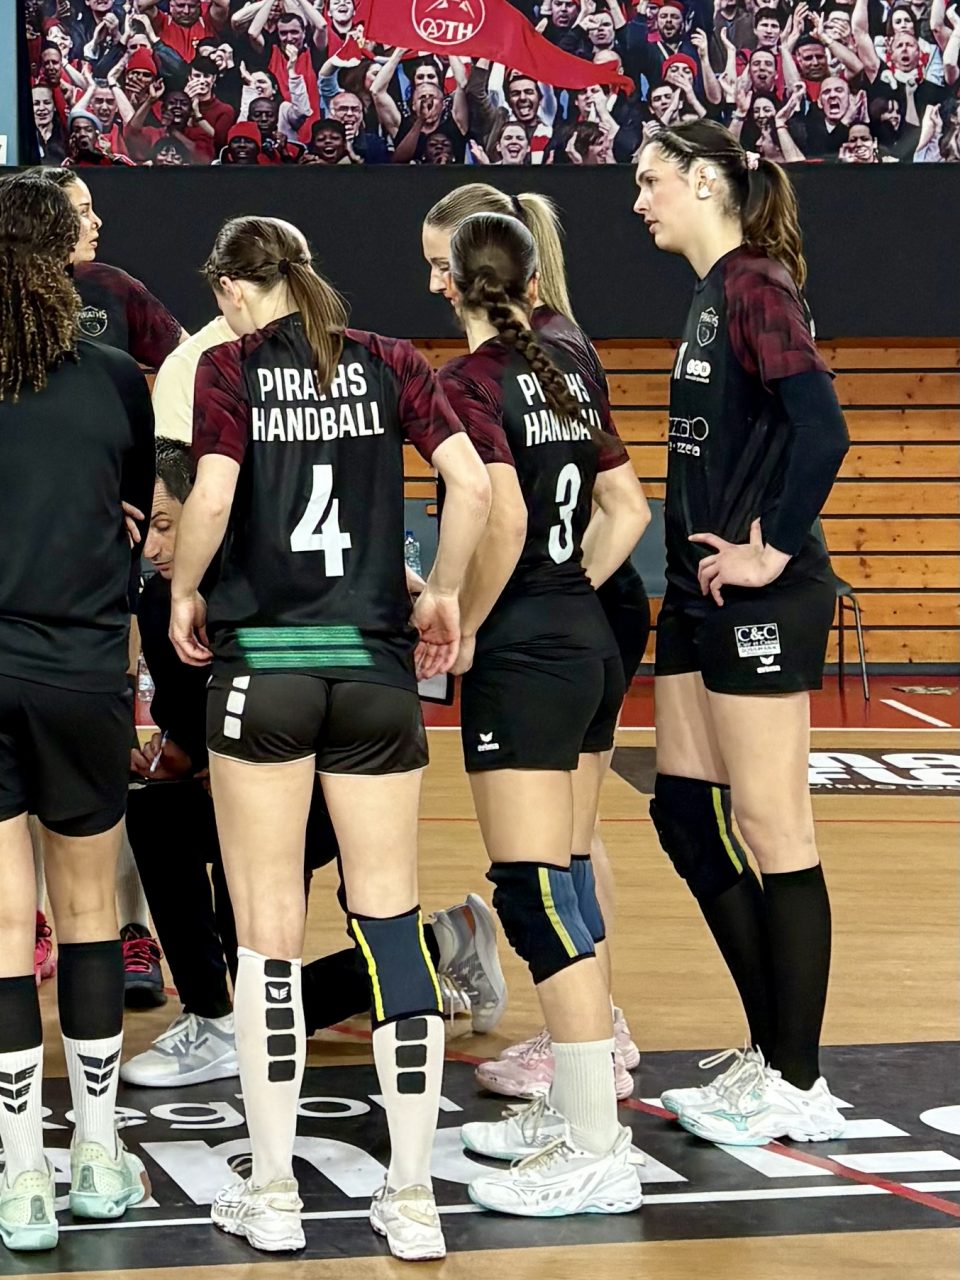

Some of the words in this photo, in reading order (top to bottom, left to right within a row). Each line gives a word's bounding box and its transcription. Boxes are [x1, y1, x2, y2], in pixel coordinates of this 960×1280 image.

[257, 362, 368, 402] PIRAHS
[517, 372, 590, 406] PIHS
[252, 401, 385, 442] HANDBALL
[290, 464, 352, 577] 4
[548, 463, 581, 564] 3
[738, 626, 776, 641] C&C
